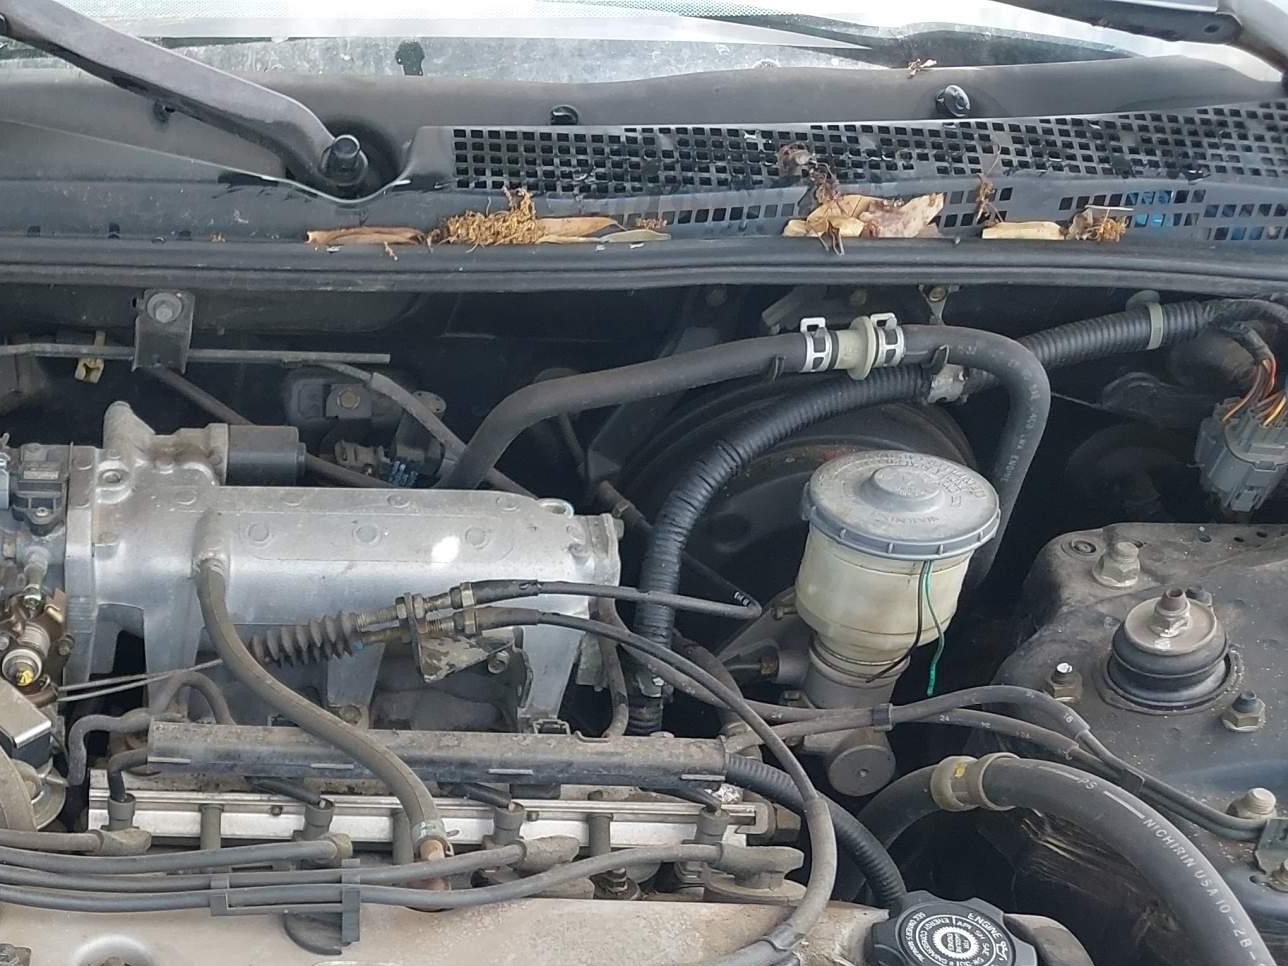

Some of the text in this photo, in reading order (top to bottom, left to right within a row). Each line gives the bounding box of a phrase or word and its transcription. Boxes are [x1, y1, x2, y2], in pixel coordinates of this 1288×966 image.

[1079, 778, 1098, 790] PS
[1144, 817, 1195, 869] NICHIRIN
[1194, 871, 1218, 898] USA
[956, 921, 972, 929] API
[967, 912, 1002, 939] ENGINE
[919, 930, 948, 965] CONSERVING
